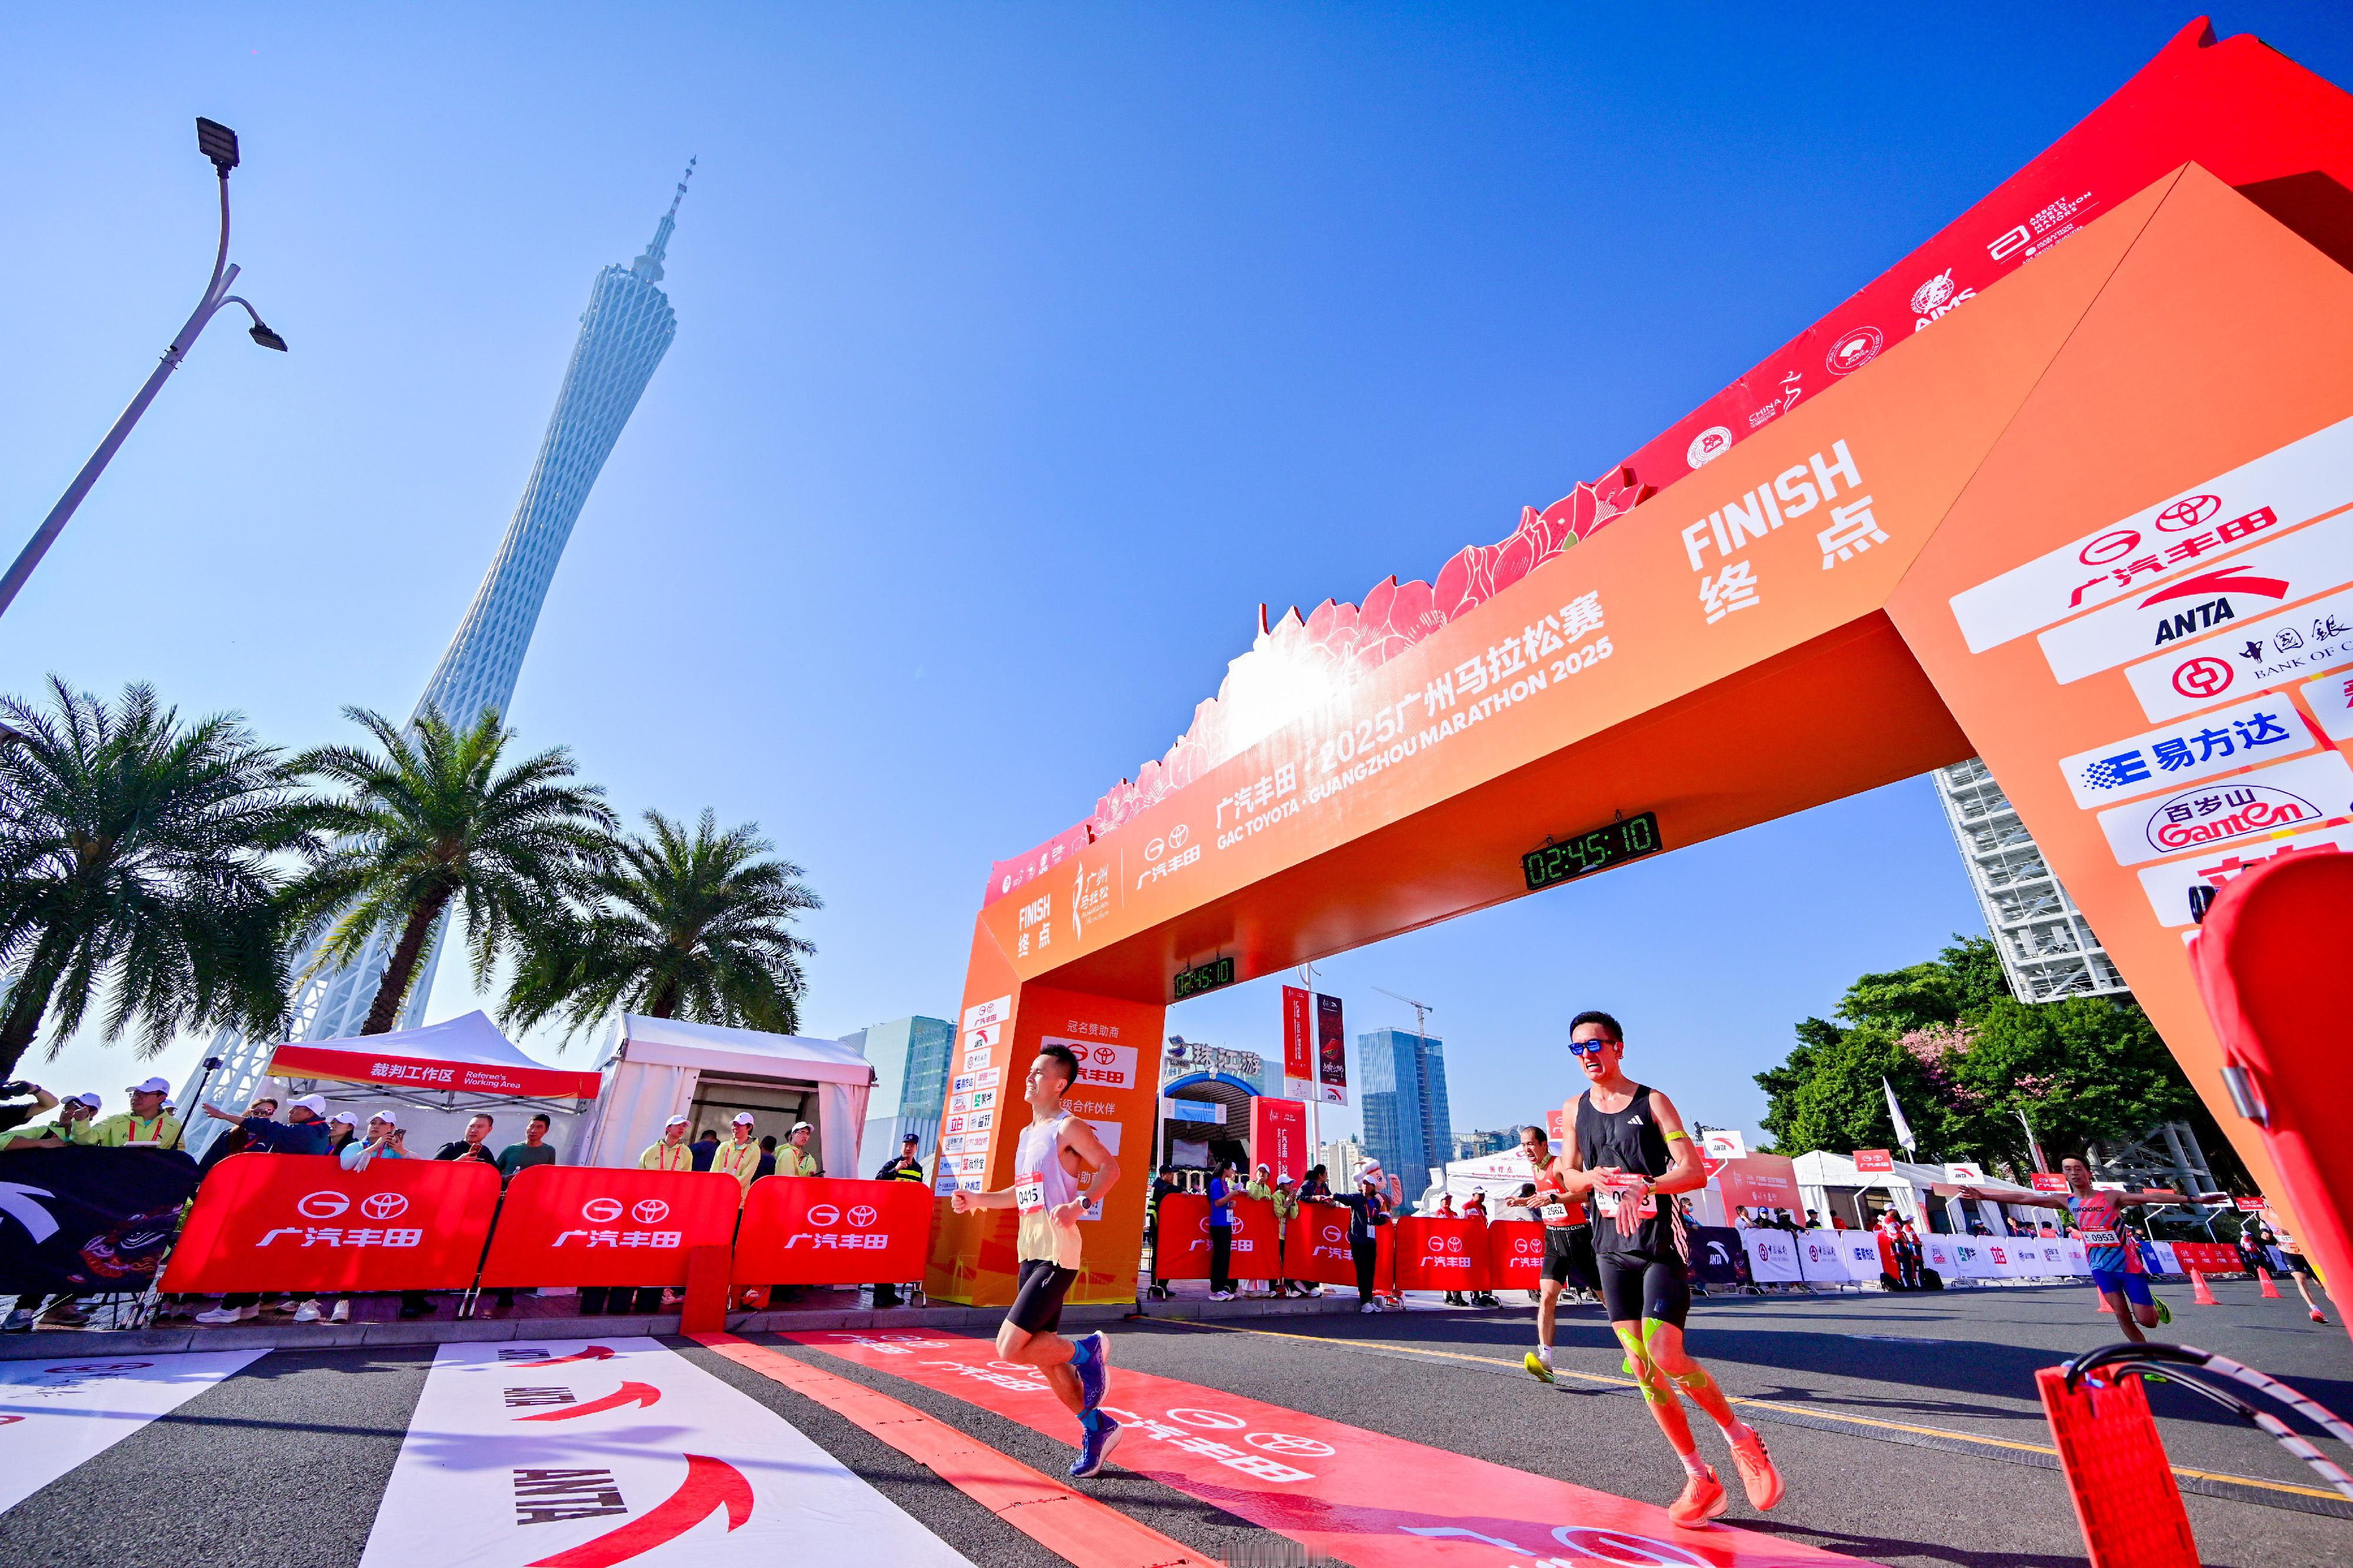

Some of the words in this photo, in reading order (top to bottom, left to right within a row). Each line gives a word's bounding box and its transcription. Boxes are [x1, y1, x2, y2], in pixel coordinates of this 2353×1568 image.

[2029, 196, 2065, 223] ABBOTT
[2031, 203, 2066, 226] WORLD
[2034, 192, 2092, 231] MARATHON
[2037, 207, 2077, 234] MAJORS
[1915, 287, 1977, 333] AIMS
[1749, 399, 1781, 421] CHINA
[1681, 439, 1862, 572] FINISH
[2068, 506, 2277, 608] 广汽丰田
[2155, 597, 2235, 646] ANTA
[2254, 657, 2306, 679] BANK
[2310, 647, 2334, 660] OF
[1217, 824, 1245, 850] GAC
[1247, 799, 1299, 838] TOYOTA
[1308, 738, 1417, 805] GUANGZHOU
[1420, 670, 1547, 747] MARATHON
[1551, 635, 1614, 686] 2025
[2152, 712, 2290, 772] 易方达
[1216, 762, 1297, 829] 广汽丰田
[2165, 789, 2257, 823] 百岁山
[1528, 818, 1652, 883] 02:45:10
[1136, 845, 1201, 890] 广汽丰田
[1081, 885, 1109, 910] 马拉松
[1019, 894, 1051, 931] FINISH
[1176, 960, 1228, 996] 02:45:10
[974, 1014, 996, 1027] 广汽丰田
[1067, 1020, 1119, 1039] 冠名赞助商
[1192, 1042, 1262, 1076] 珠江游
[371, 1062, 455, 1082] 裁判工作区
[464, 1077, 499, 1088] Working
[466, 1071, 506, 1080] Referee's
[981, 1092, 993, 1105] 蒙牛
[1060, 1098, 1115, 1116] 级合作伙伴
[951, 1116, 963, 1132] 立白
[978, 1115, 991, 1127] 益节
[1019, 1189, 1038, 1205] 0415
[1598, 1191, 1604, 1199] A
[1547, 1206, 1564, 1215] 2962
[255, 1228, 423, 1247] 广汽丰田
[551, 1230, 682, 1249] 广汽丰田
[784, 1234, 889, 1250] 广汽丰田
[2091, 1233, 2115, 1242] 0953
[1420, 1256, 1471, 1267] 广汽丰田
[1709, 1255, 1722, 1265] ANTA
[1861, 1248, 1875, 1260] 易方达
[1990, 1246, 2007, 1264] 立白
[498, 1349, 552, 1361] ANTA
[918, 1361, 1052, 1391] 广汽丰田
[504, 1387, 577, 1407] ANTA
[1099, 1407, 1317, 1482] 广汽丰田
[513, 1469, 628, 1526] ANTA
